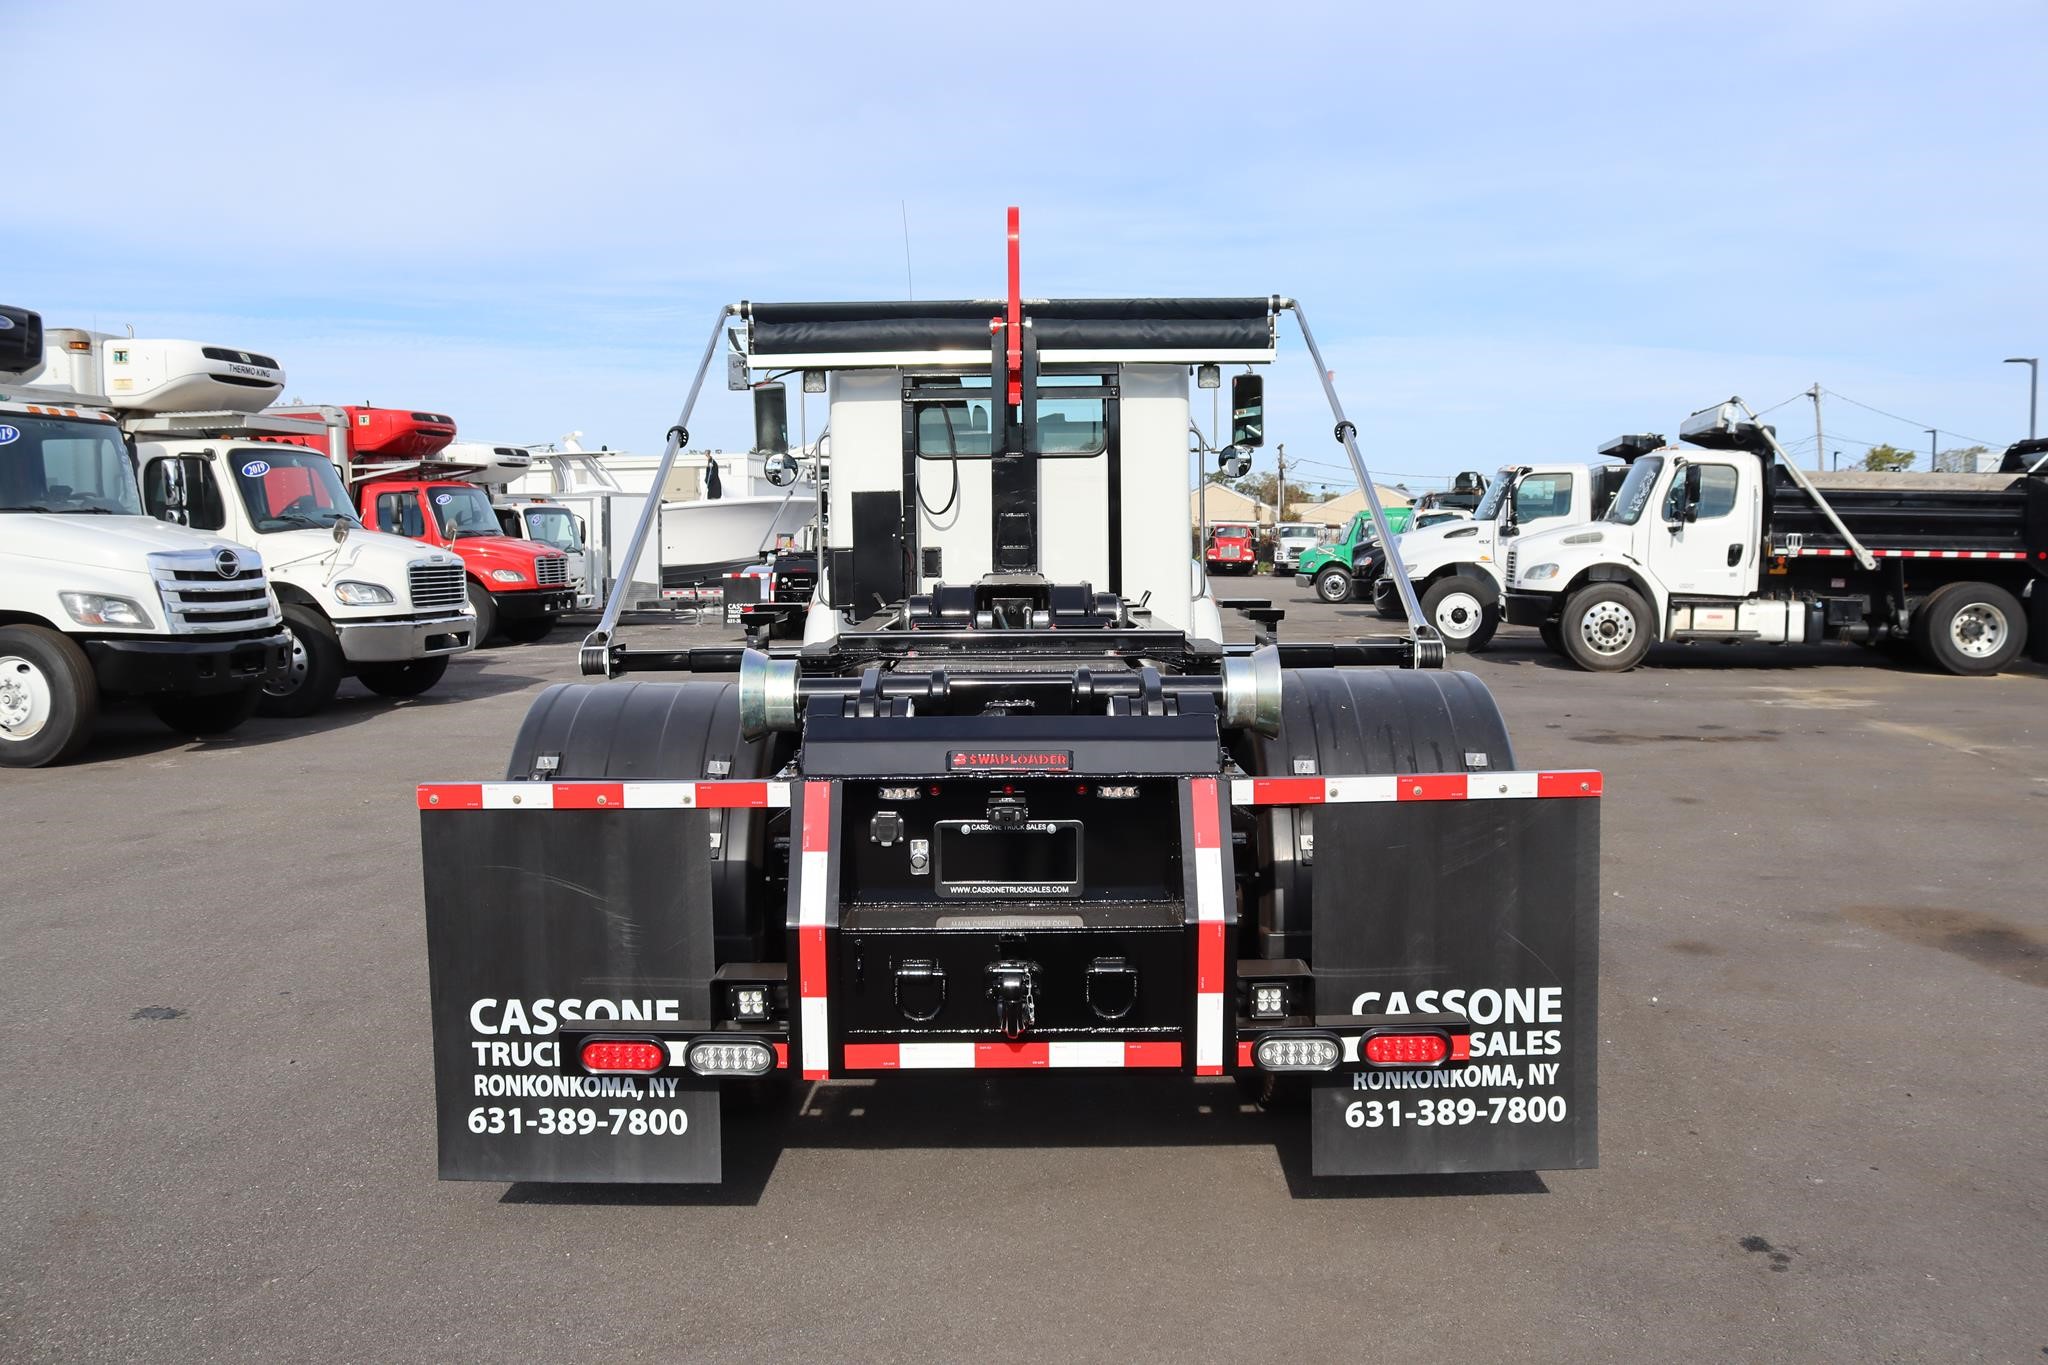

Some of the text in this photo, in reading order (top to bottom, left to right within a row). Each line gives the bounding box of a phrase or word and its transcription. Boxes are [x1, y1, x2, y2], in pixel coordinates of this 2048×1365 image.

[229, 363, 271, 378] THERMO KING
[247, 463, 266, 475] 2019
[969, 753, 1067, 765] SWAPLOADER
[971, 823, 1002, 832] CASSONE
[1026, 823, 1047, 832] SALES
[950, 886, 1069, 894] WWW.CASSONETRUCKSALES.COM
[1352, 987, 1563, 1025] CASSONE
[1469, 1030, 1562, 1058] SALES
[474, 1074, 680, 1101] RONKONKOMA, NY
[1353, 1063, 1560, 1091] RONKONKOMA, NY
[467, 1107, 689, 1136] 631-389-7800
[1345, 1095, 1567, 1129] 631-389-7800
